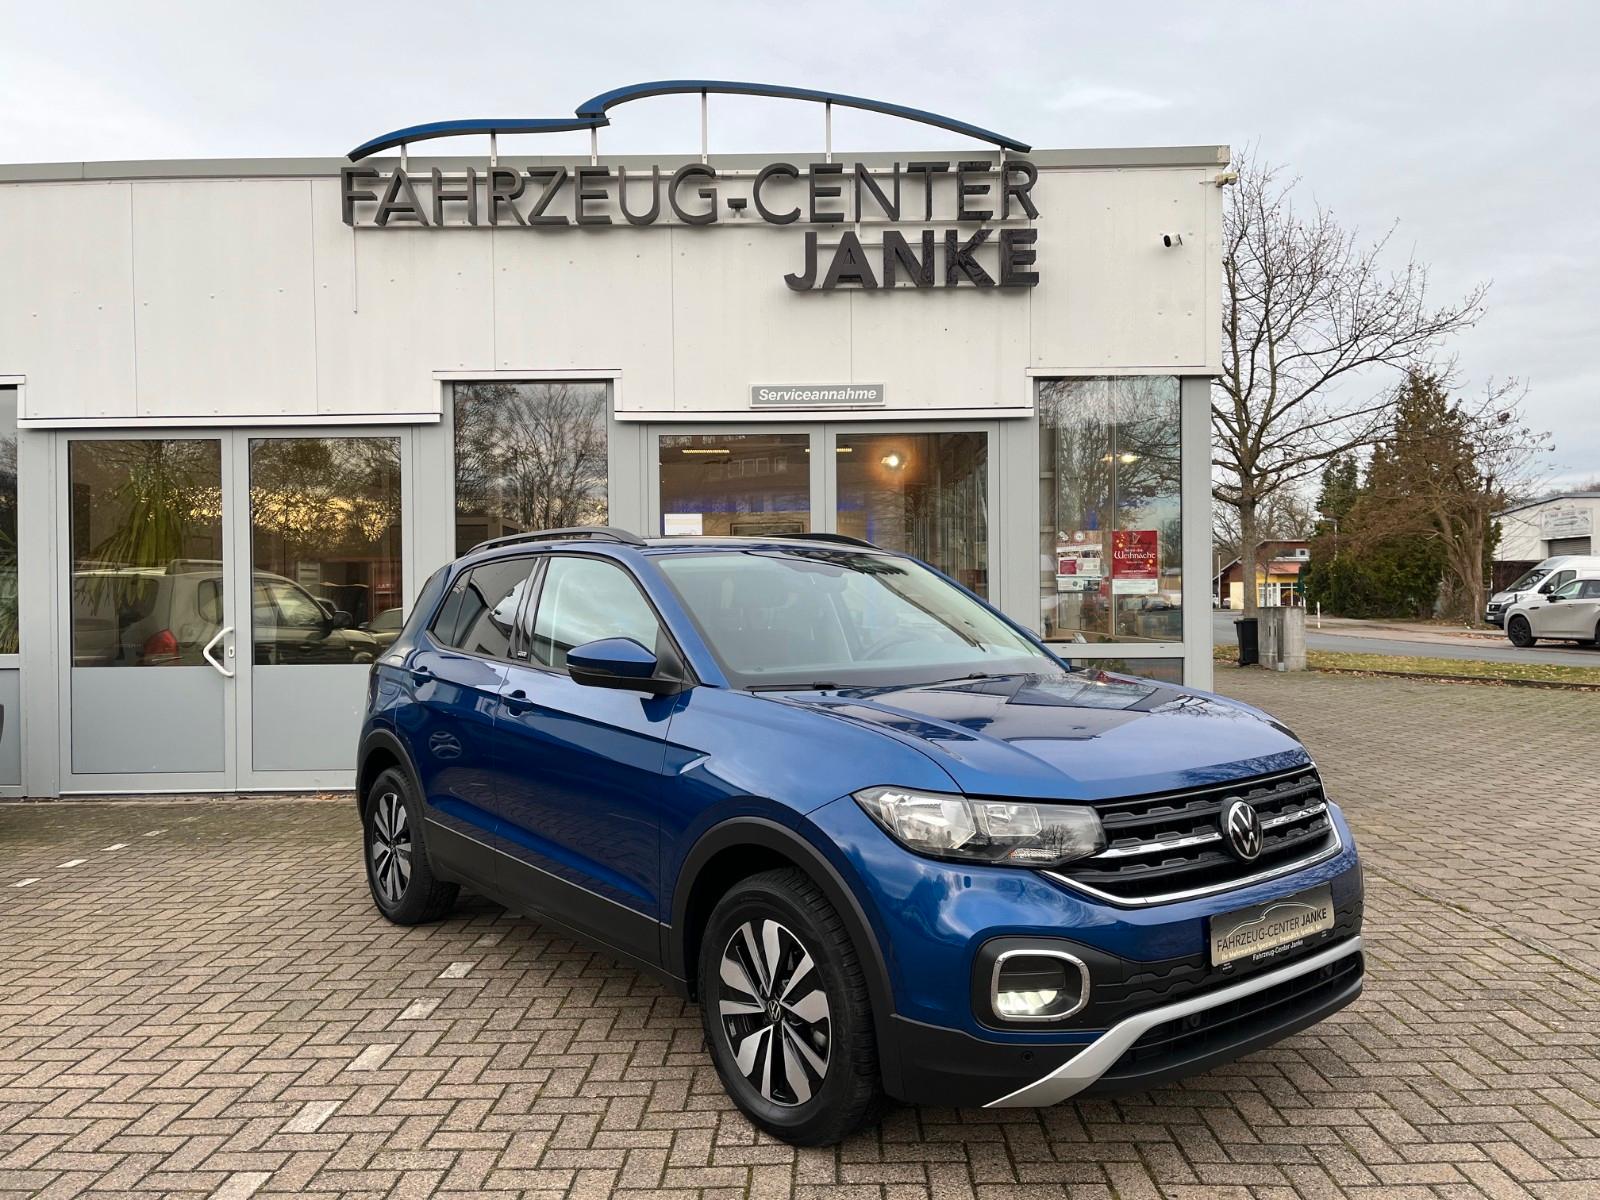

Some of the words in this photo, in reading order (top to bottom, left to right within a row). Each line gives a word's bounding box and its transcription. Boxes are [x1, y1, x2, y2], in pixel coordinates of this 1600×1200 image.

[341, 161, 1039, 226] FAHRZEUG-CENTER
[784, 228, 1039, 290] JANKE
[759, 387, 877, 401] Serviceannahme
[1216, 916, 1300, 952] FAHRZEUG-CENTER
[1301, 908, 1327, 926] JANKE
[1252, 943, 1290, 961] Fahrzeug-Center
[1290, 939, 1304, 949] Janke
